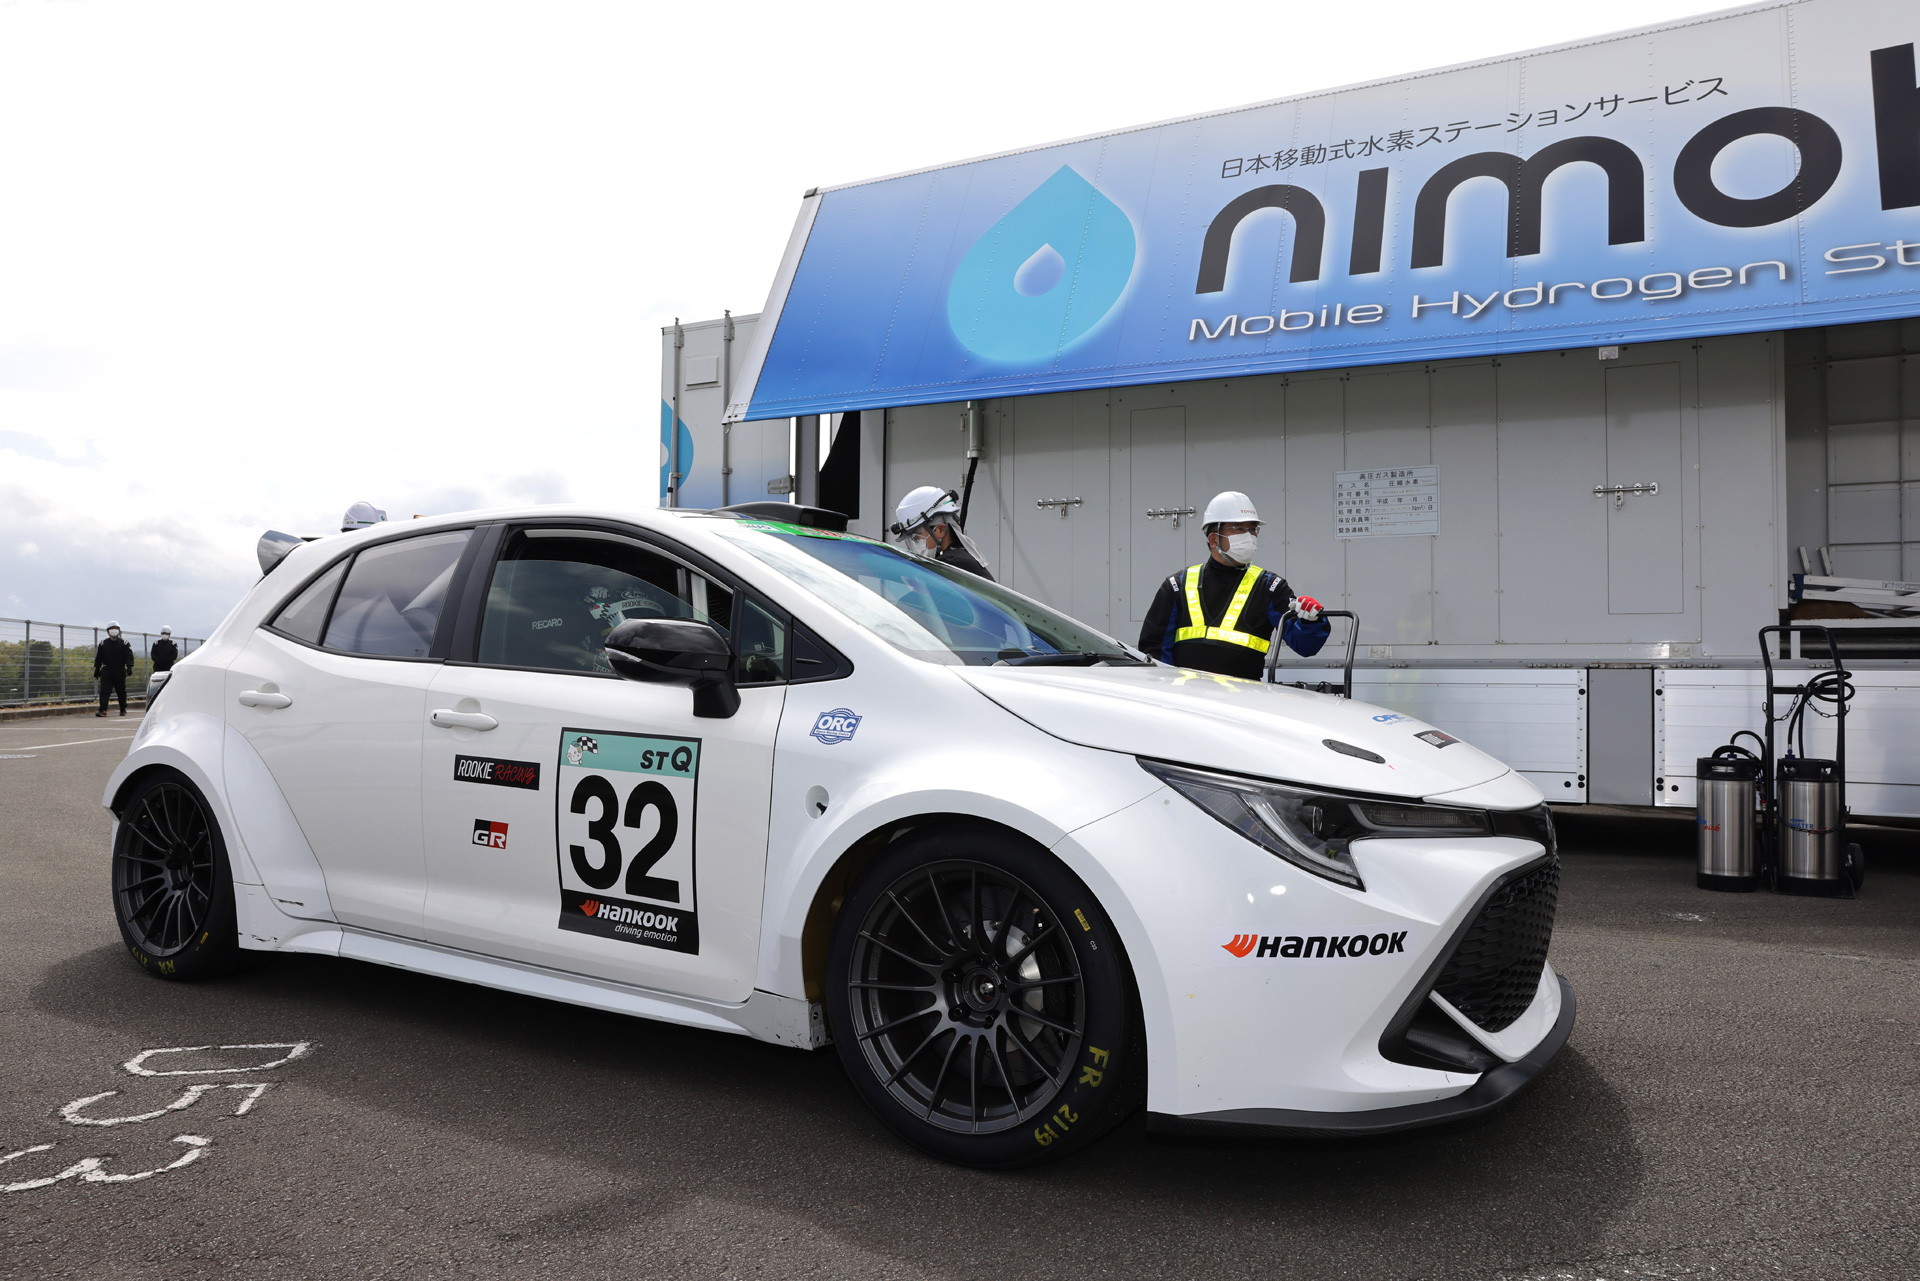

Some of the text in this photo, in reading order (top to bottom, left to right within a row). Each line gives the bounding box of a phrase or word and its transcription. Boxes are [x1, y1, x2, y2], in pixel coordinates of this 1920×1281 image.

[1221, 77, 1728, 179] 日本移動式水素ステーションサービス
[1189, 303, 1384, 340] Mobile
[1411, 259, 1786, 320] Hydrogen
[531, 618, 563, 630] RECARO
[818, 716, 857, 732] ORC
[457, 759, 536, 785] ROOKIE RACING
[473, 829, 506, 848] GR
[569, 775, 680, 903] 32
[614, 923, 678, 943] driving emotion
[1079, 1046, 1110, 1088] FR
